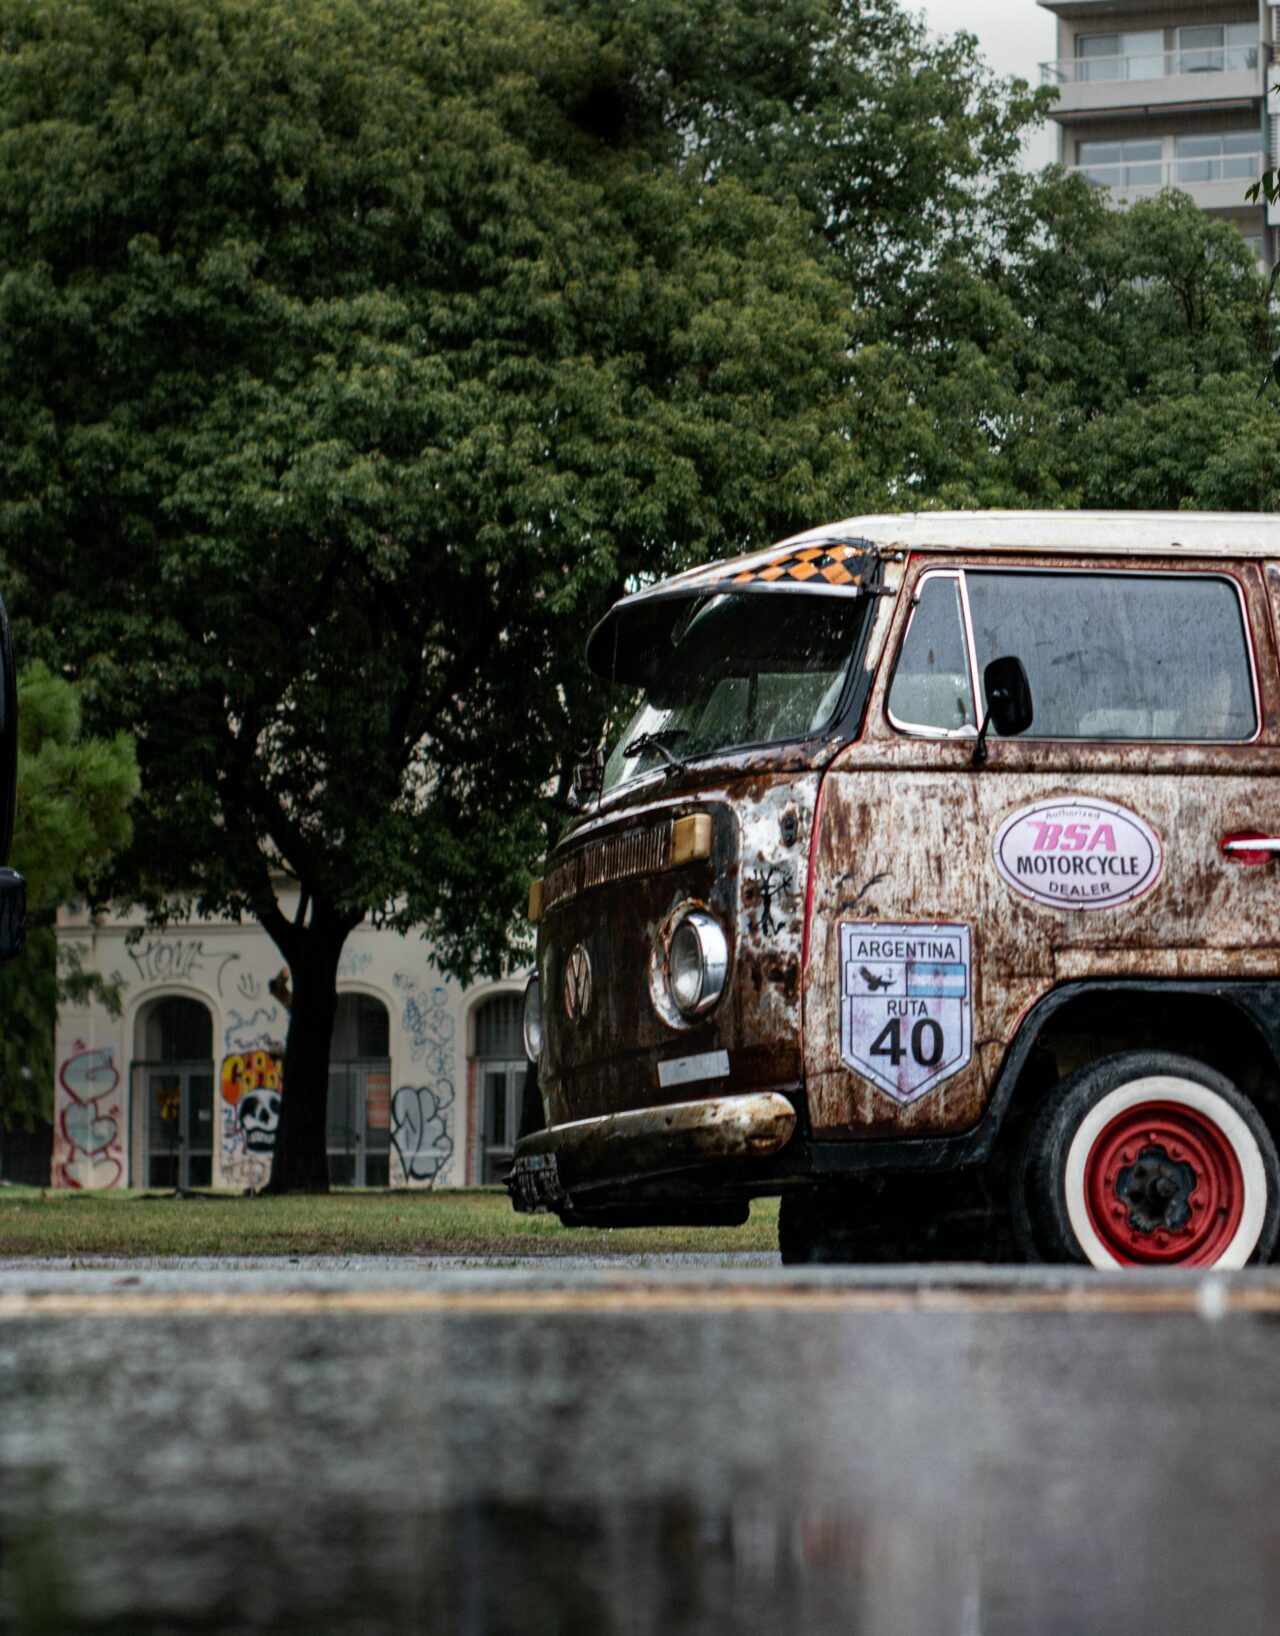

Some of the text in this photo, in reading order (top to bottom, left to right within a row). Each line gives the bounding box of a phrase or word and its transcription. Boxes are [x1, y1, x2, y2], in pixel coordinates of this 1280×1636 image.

[1045, 808, 1101, 820] Authorized
[1027, 821, 1117, 852] BSA
[1016, 855, 1139, 876] MOTORCYCLE
[1049, 881, 1112, 897] DEALER
[857, 941, 955, 959] ARGENTINA
[887, 1000, 928, 1016] RUTA
[869, 1018, 944, 1067] 40
